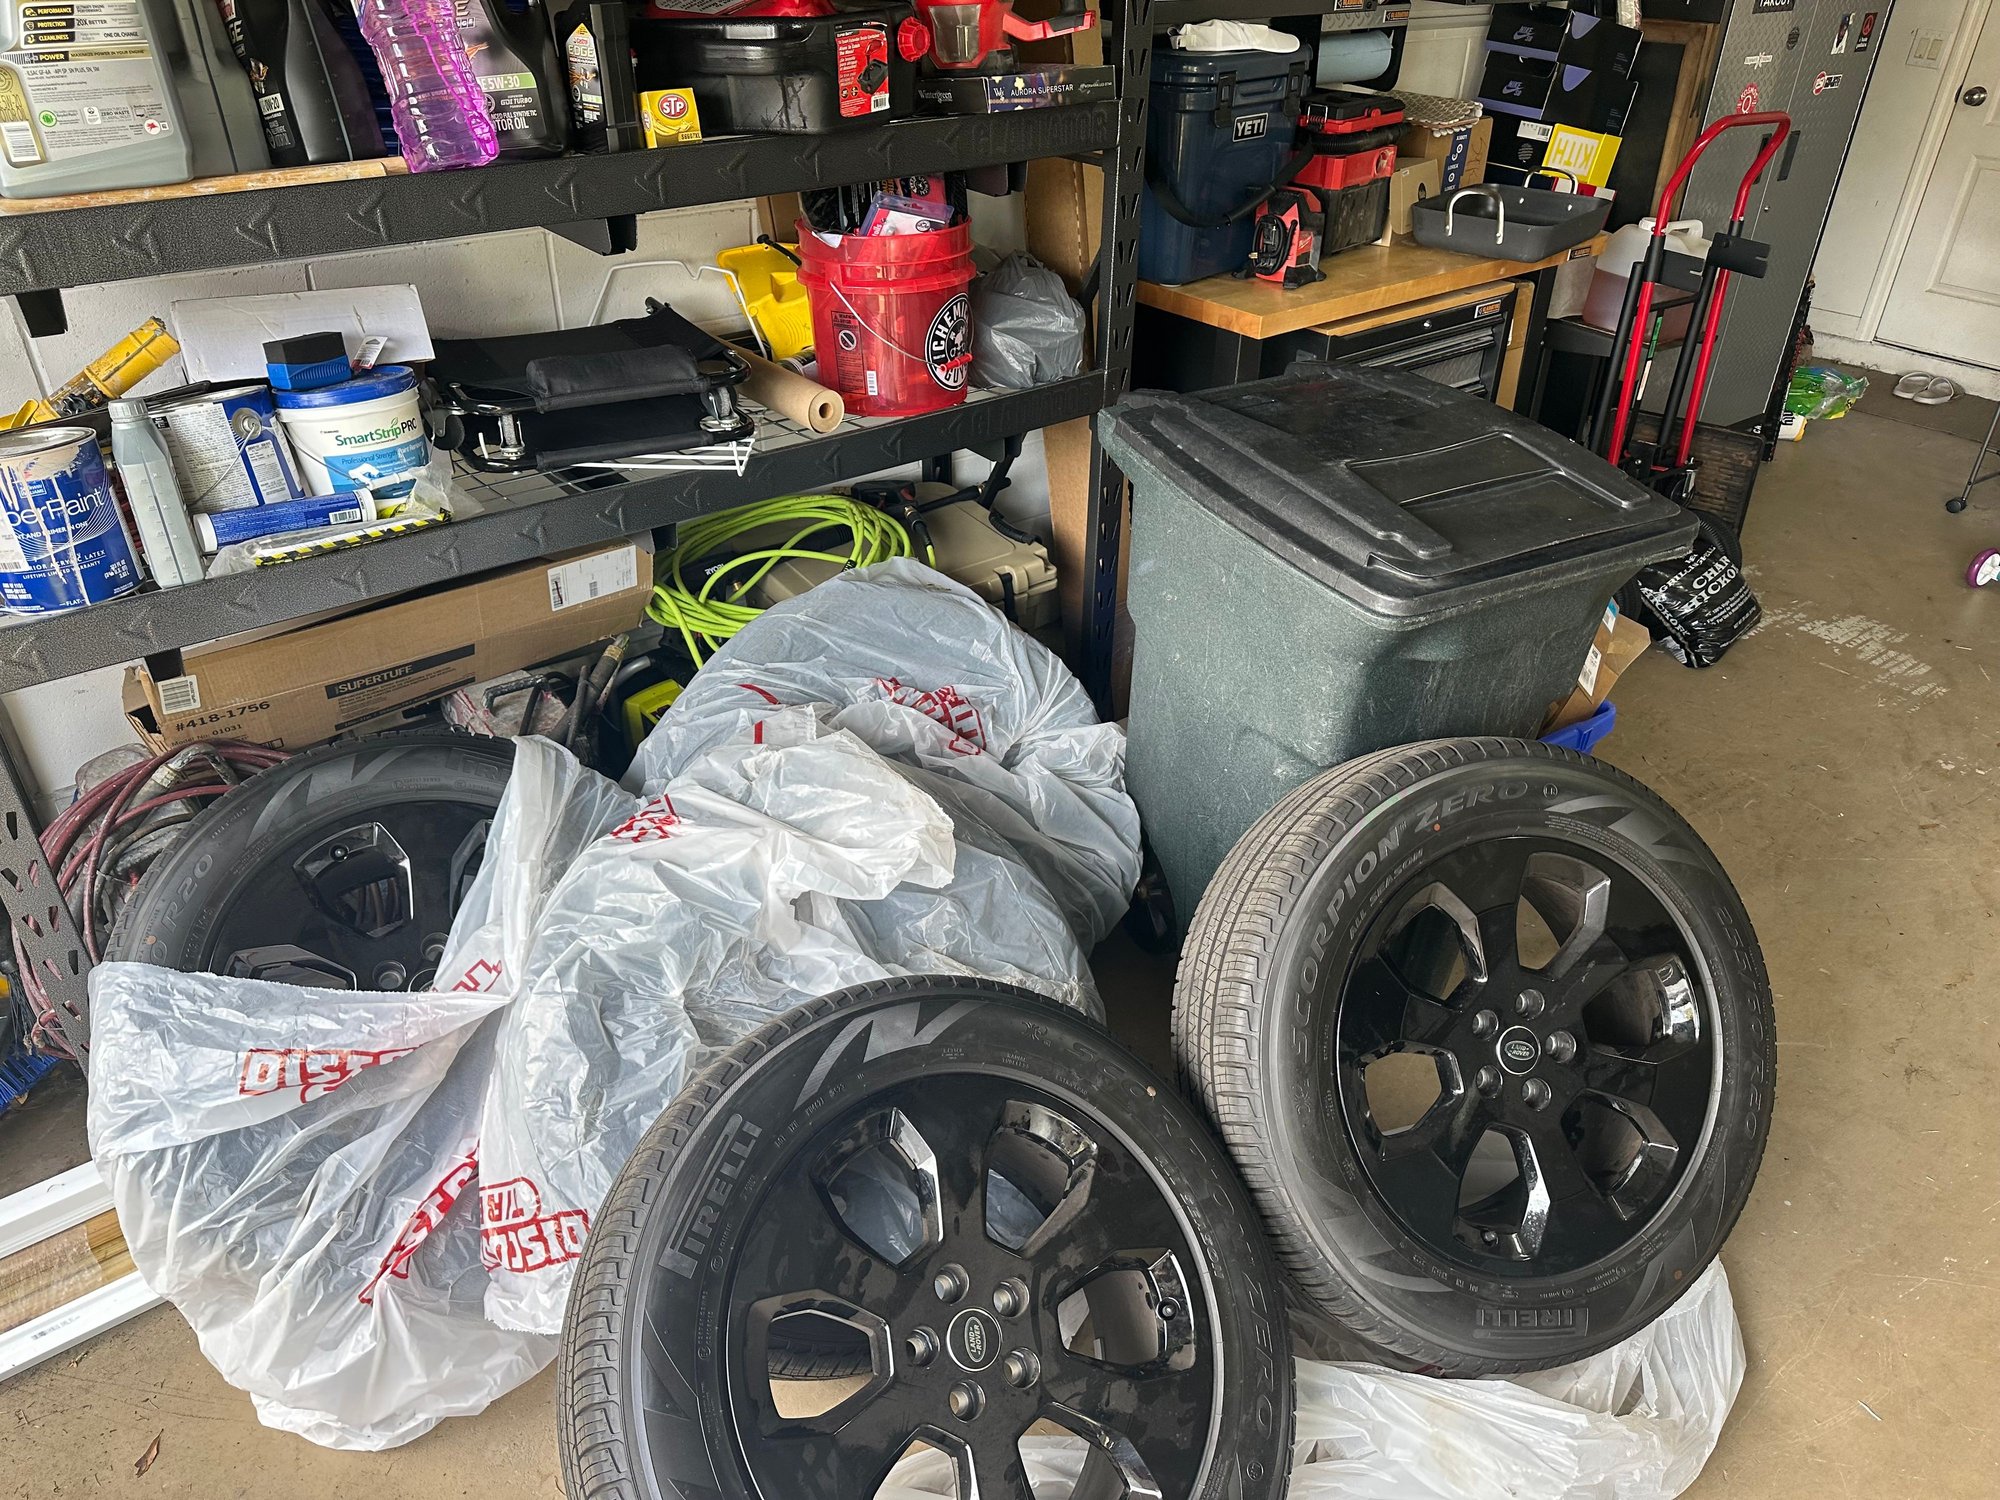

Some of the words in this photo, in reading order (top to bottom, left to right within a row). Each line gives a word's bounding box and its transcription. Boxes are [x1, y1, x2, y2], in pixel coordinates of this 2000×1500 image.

[568, 45, 595, 58] EDGE
[489, 75, 520, 89] 5W-30
[1010, 86, 1037, 97] AURORA
[1037, 84, 1074, 95] SUPERSTAR
[514, 96, 533, 104] TURBO
[662, 97, 685, 115] STP
[513, 109, 538, 117] SYNTHETIC
[514, 116, 530, 129] OIL
[1236, 118, 1266, 137] YETI
[1551, 138, 1595, 169] KITH
[341, 454, 375, 465] Professional
[375, 449, 398, 460] Strength
[84, 550, 106, 560] LATEX
[175, 701, 271, 732] #418-1756
[212, 724, 243, 736] 01031
[1415, 780, 1529, 832] ZERO
[1369, 848, 1425, 908] SEASON
[161, 854, 214, 934] R20
[1291, 825, 1401, 1064] SCORPION
[658, 1113, 763, 1280] PIRELLI
[1473, 1307, 1590, 1339] PIRELLI
[1241, 1271, 1275, 1441] ZERO
